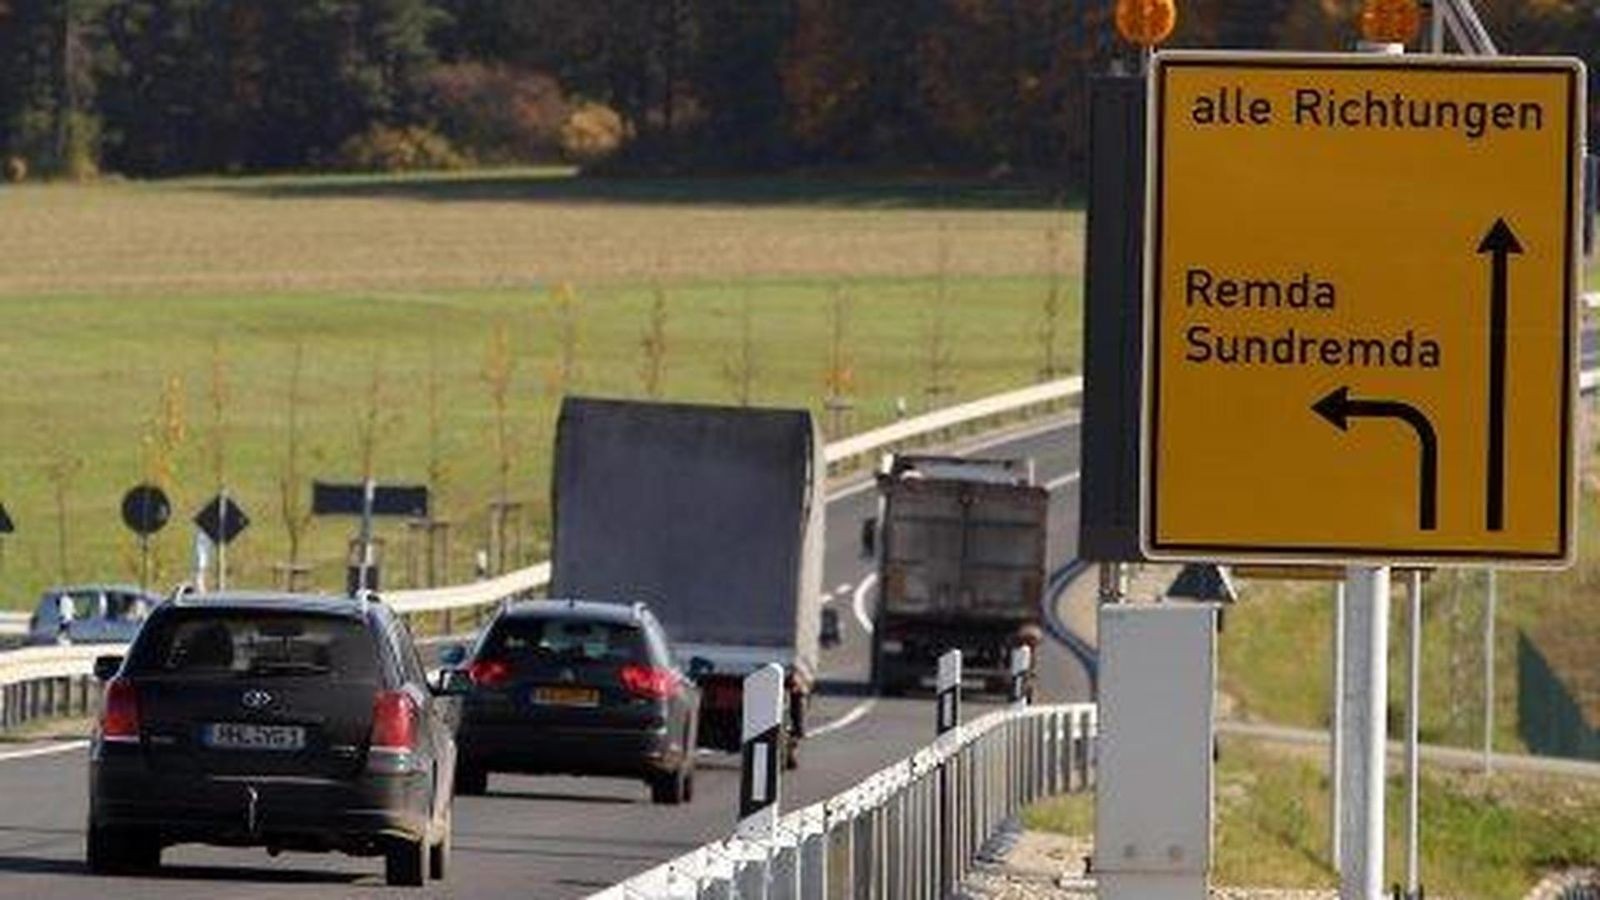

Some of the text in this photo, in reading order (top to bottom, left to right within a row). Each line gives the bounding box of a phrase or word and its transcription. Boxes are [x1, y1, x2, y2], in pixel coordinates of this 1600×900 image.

[1192, 87, 1543, 138] alle Richtungen
[1186, 269, 1336, 309] Remda
[1186, 325, 1441, 368] Sundremda
